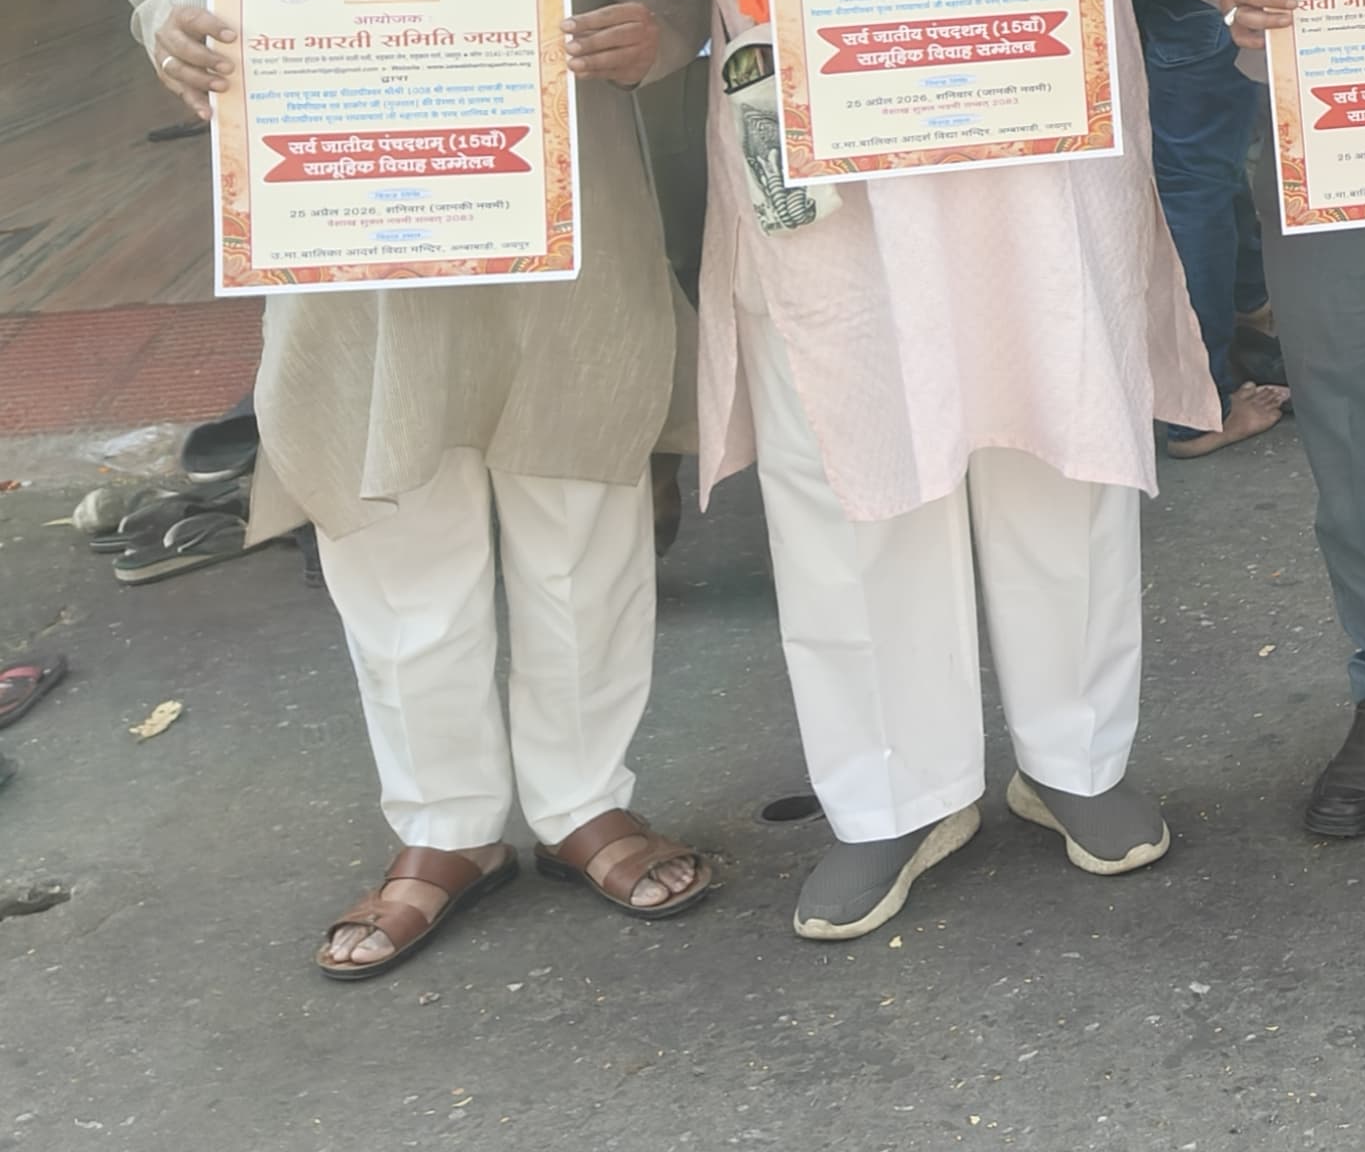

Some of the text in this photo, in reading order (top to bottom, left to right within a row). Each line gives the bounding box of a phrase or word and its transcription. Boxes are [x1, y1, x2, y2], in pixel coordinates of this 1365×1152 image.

[251, 28, 532, 50] सेवा भारती समिति जयपुर
